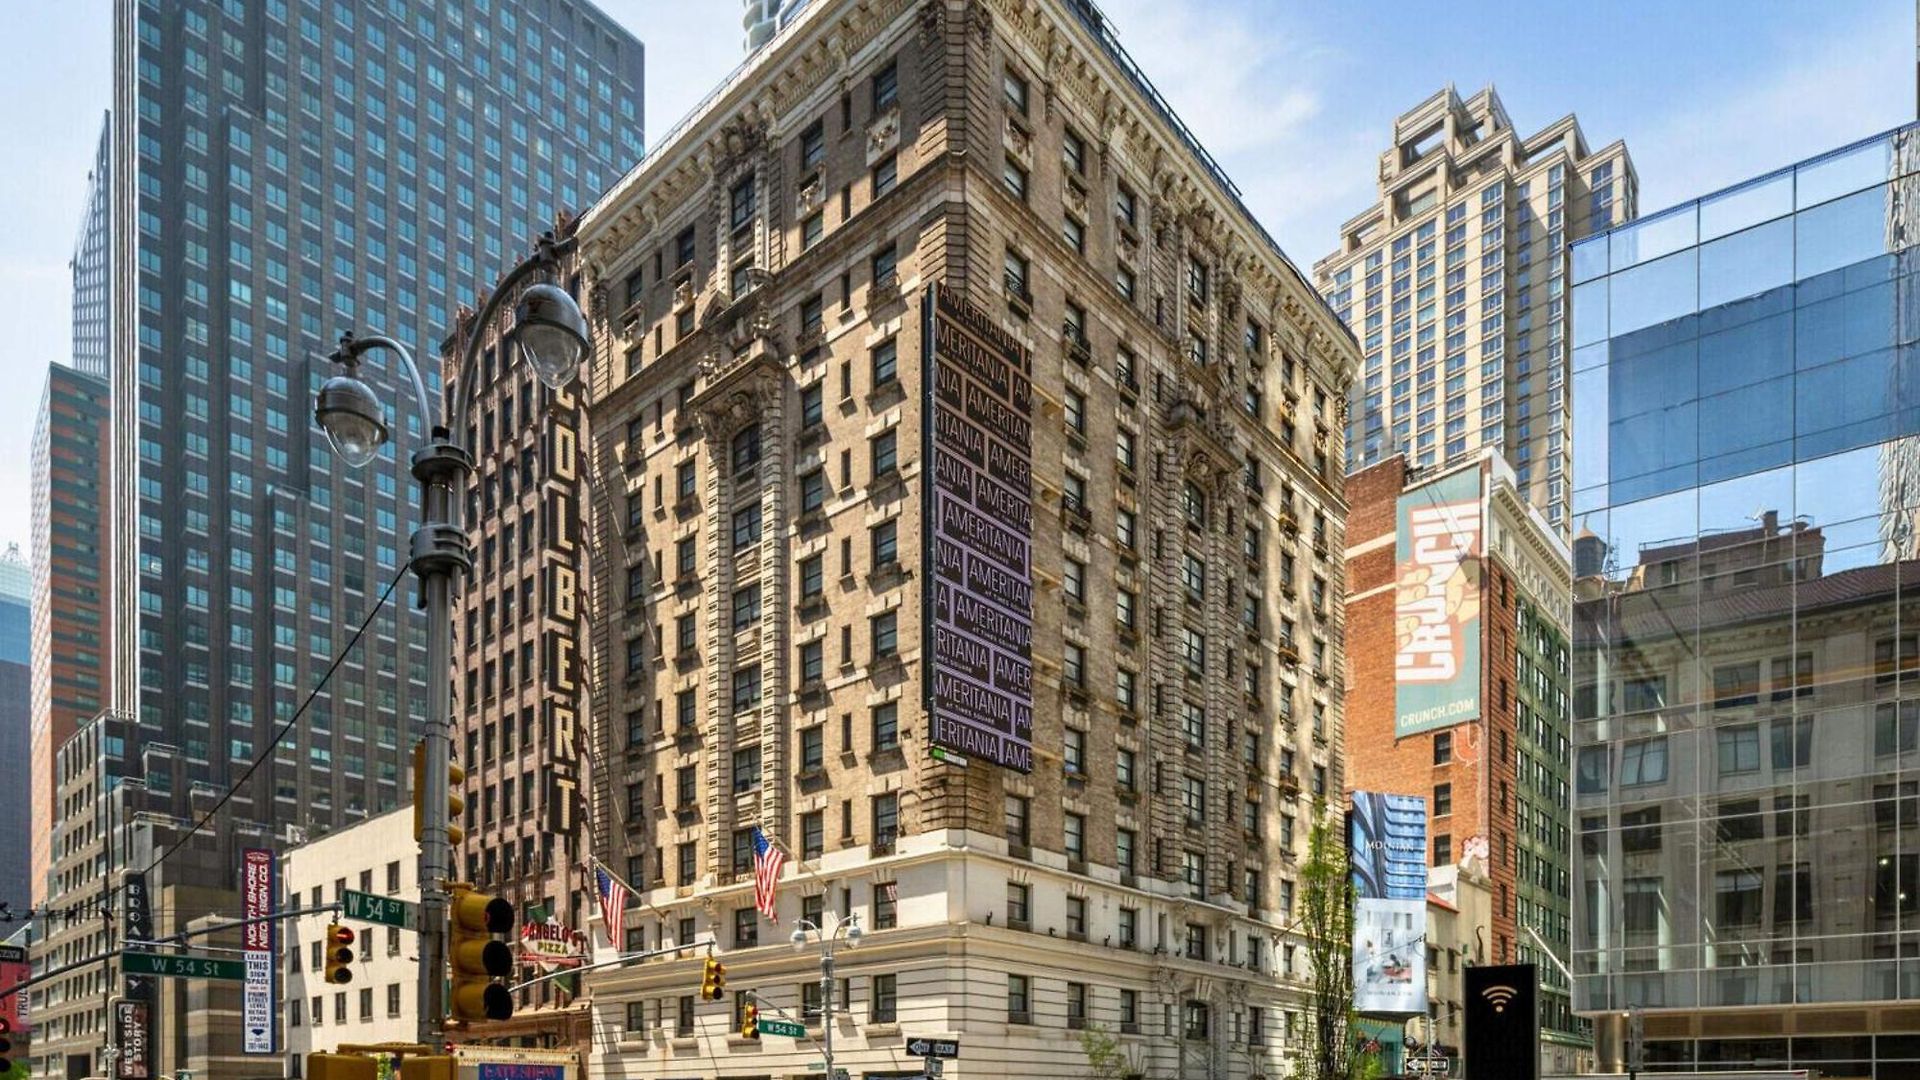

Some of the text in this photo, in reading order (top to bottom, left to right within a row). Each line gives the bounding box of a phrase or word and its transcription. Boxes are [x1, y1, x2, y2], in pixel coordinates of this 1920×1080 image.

[945, 499, 1023, 563] AMERITANIA
[1396, 502, 1480, 680] CRUNCH
[955, 592, 1031, 649] AMERITANIA
[1401, 698, 1475, 728] CRUNCH.COM
[936, 716, 996, 754] ERITANIA
[247, 862, 257, 904] SHORE
[259, 884, 268, 912] SIGN
[348, 892, 400, 920] W 54 ST
[538, 942, 568, 954] PIZZA
[152, 958, 220, 976] W 54 St
[248, 961, 268, 970] THIS
[124, 1007, 133, 1076] WEST SIDE
[134, 1021, 142, 1062] STORY
[776, 1025, 786, 1034] 54
[788, 1026, 797, 1035] St
